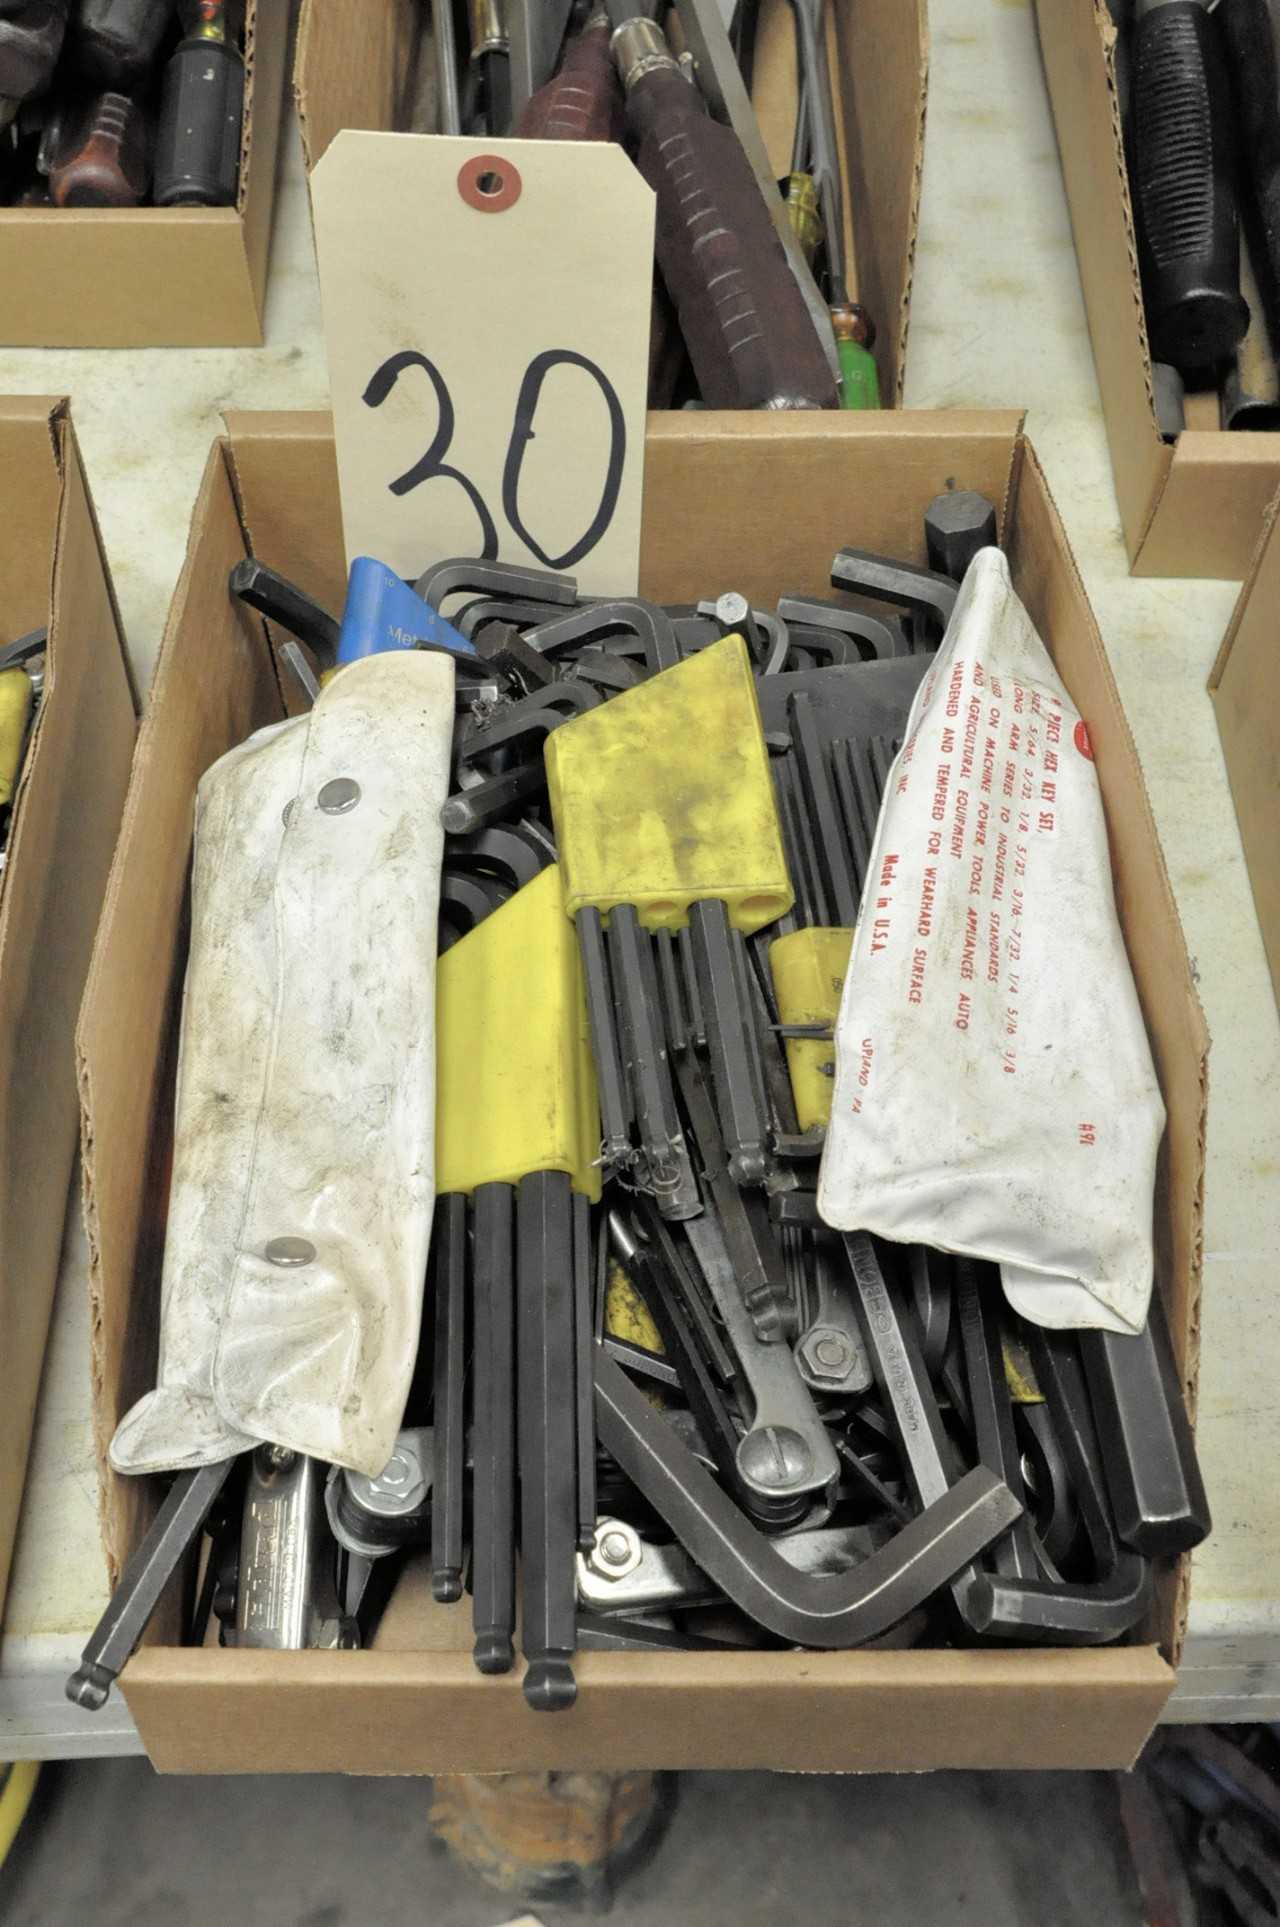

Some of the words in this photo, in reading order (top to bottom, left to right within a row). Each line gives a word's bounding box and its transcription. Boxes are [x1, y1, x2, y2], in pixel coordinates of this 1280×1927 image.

[361, 348, 626, 569] 30
[946, 661, 964, 717] HARDENED
[973, 662, 984, 686] AND
[990, 676, 1002, 697] USED
[989, 708, 1000, 728] ON
[1045, 712, 1061, 744] PIECE
[940, 728, 955, 753] AND
[960, 696, 981, 779] AGRICULTURAL
[1009, 723, 1020, 751] ARM
[980, 738, 996, 793] MACHINE
[1003, 760, 1016, 797] SERIES
[1043, 750, 1058, 772] HEX
[932, 764, 951, 821] TEMPERED
[1041, 781, 1056, 802] KEY
[949, 790, 968, 858] EQUIPMENT
[1000, 808, 1011, 823] TO
[927, 831, 941, 855] FOR
[880, 855, 899, 886] Made
[991, 833, 1008, 901] INDUSTRIAL
[877, 897, 892, 908] in
[917, 867, 937, 936] WEARHARD
[870, 920, 889, 956] U.S.A.
[987, 912, 1000, 984] STANDARDS
[909, 948, 928, 1004] SURFACE
[955, 993, 970, 1030] AUTO
[857, 1038, 874, 1087] UPLAND
